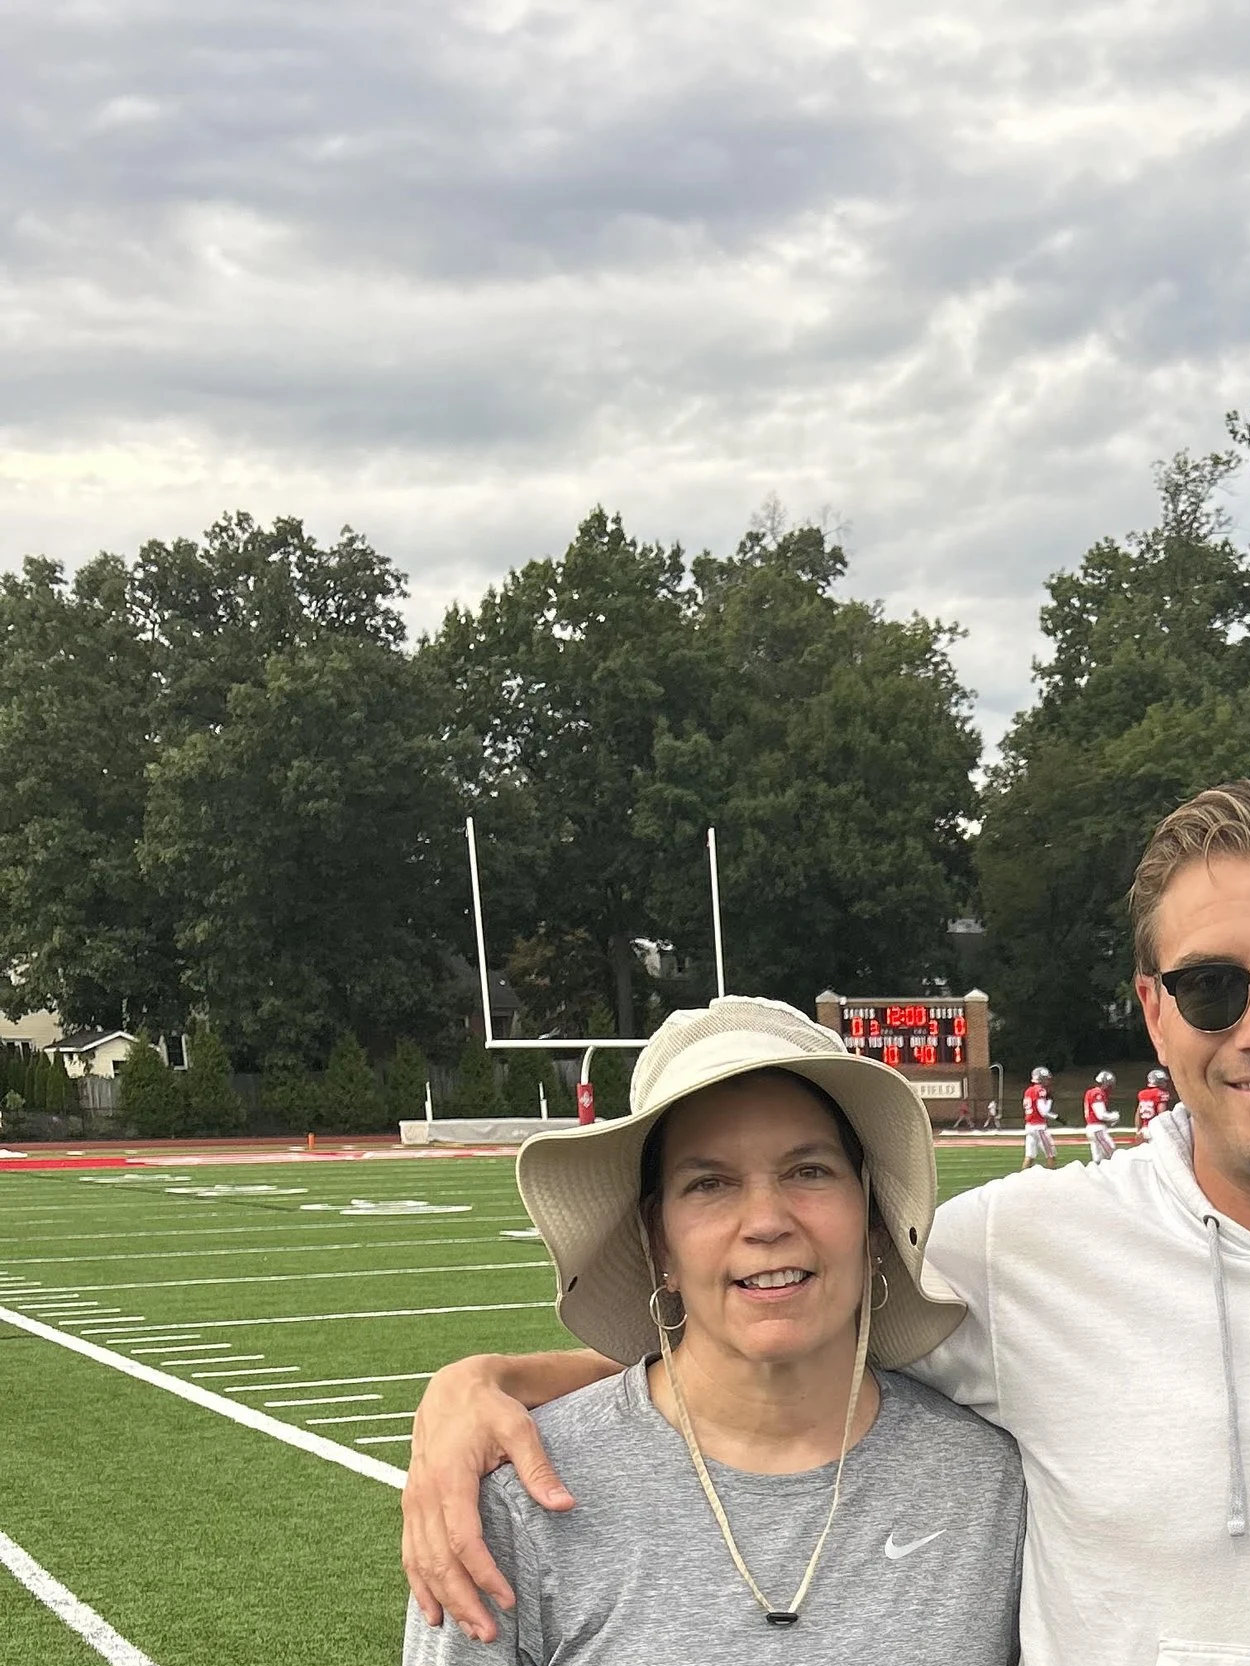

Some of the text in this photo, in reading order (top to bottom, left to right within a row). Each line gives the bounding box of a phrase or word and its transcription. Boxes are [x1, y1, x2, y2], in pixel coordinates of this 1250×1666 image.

[886, 1006, 927, 1026] 12:00
[954, 1016, 966, 1036] 0
[852, 1016, 864, 1037] 0
[929, 1020, 939, 1036] 3
[920, 1085, 956, 1096] FIELD
